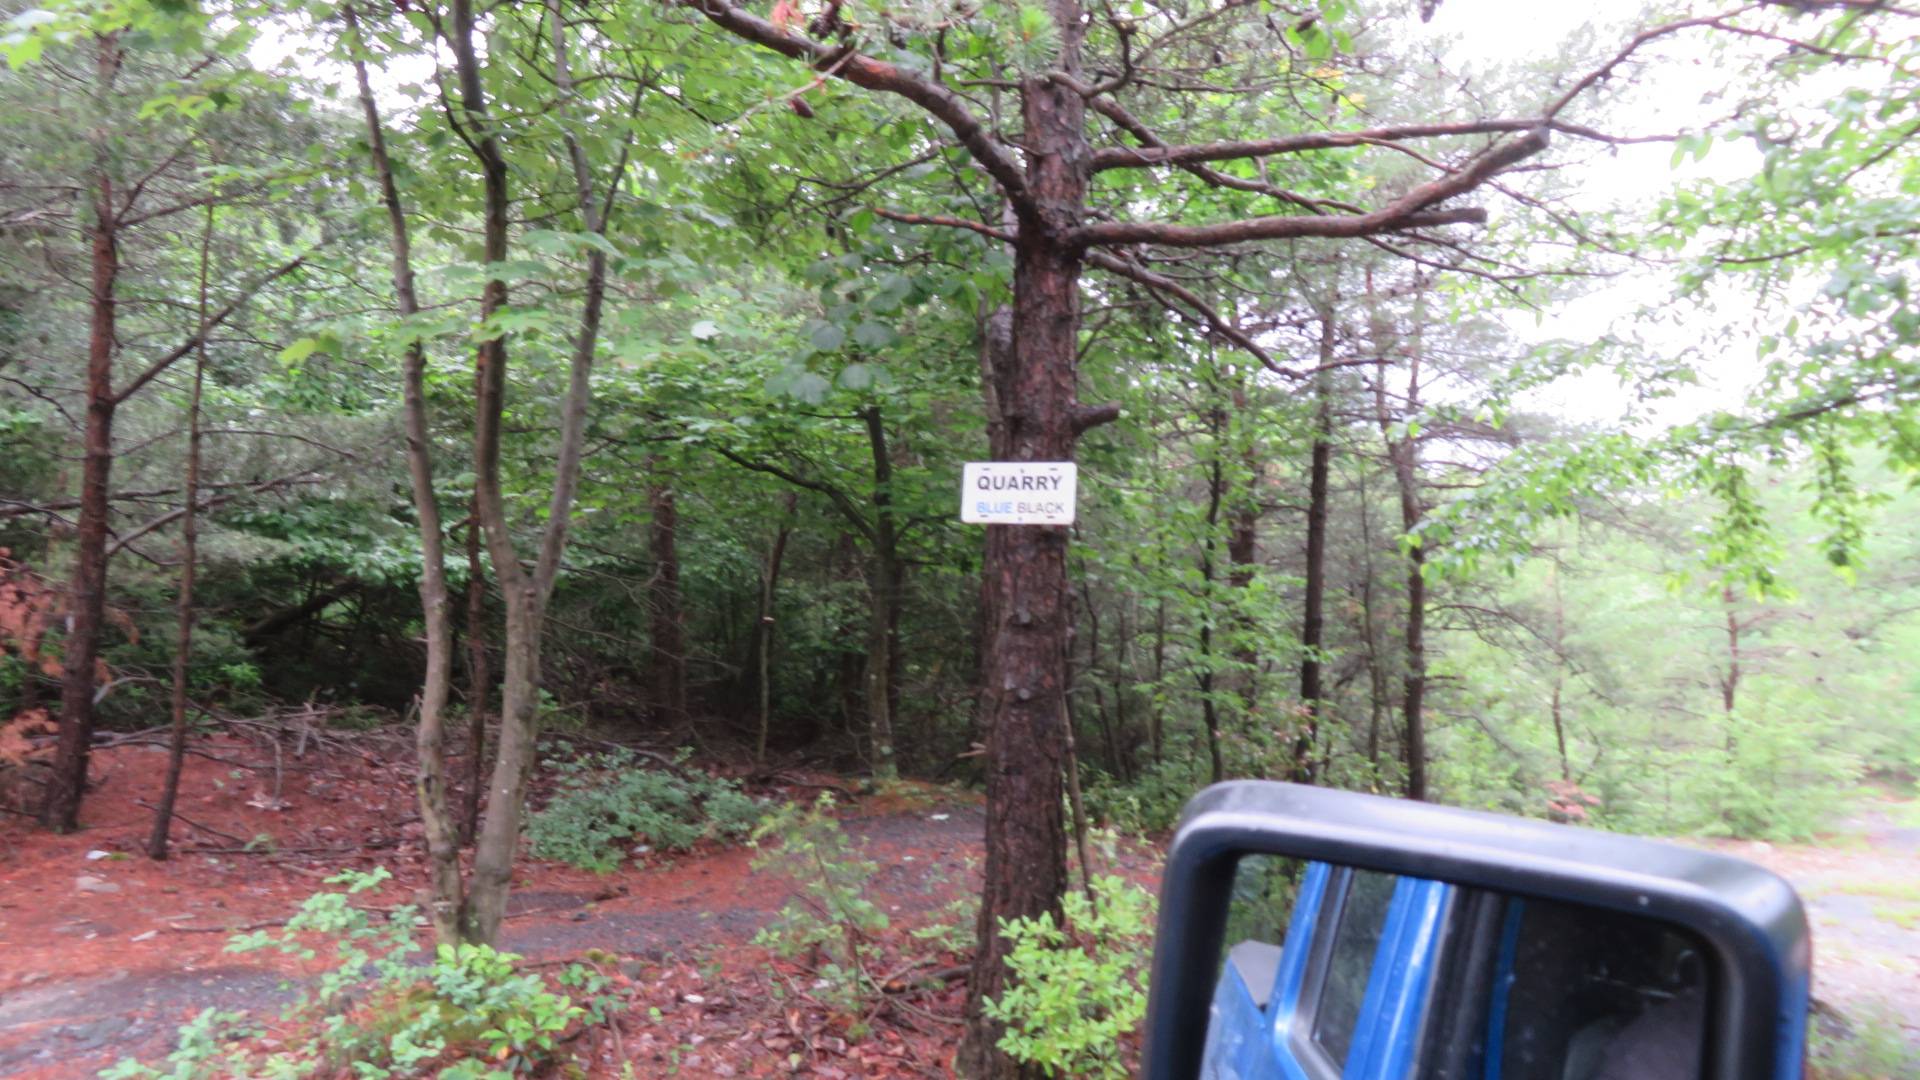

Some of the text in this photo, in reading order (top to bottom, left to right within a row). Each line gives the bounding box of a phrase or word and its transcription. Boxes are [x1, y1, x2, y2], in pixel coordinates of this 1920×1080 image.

[977, 475, 1062, 491] QUARRY
[976, 501, 1065, 514] BLUE BLACK
